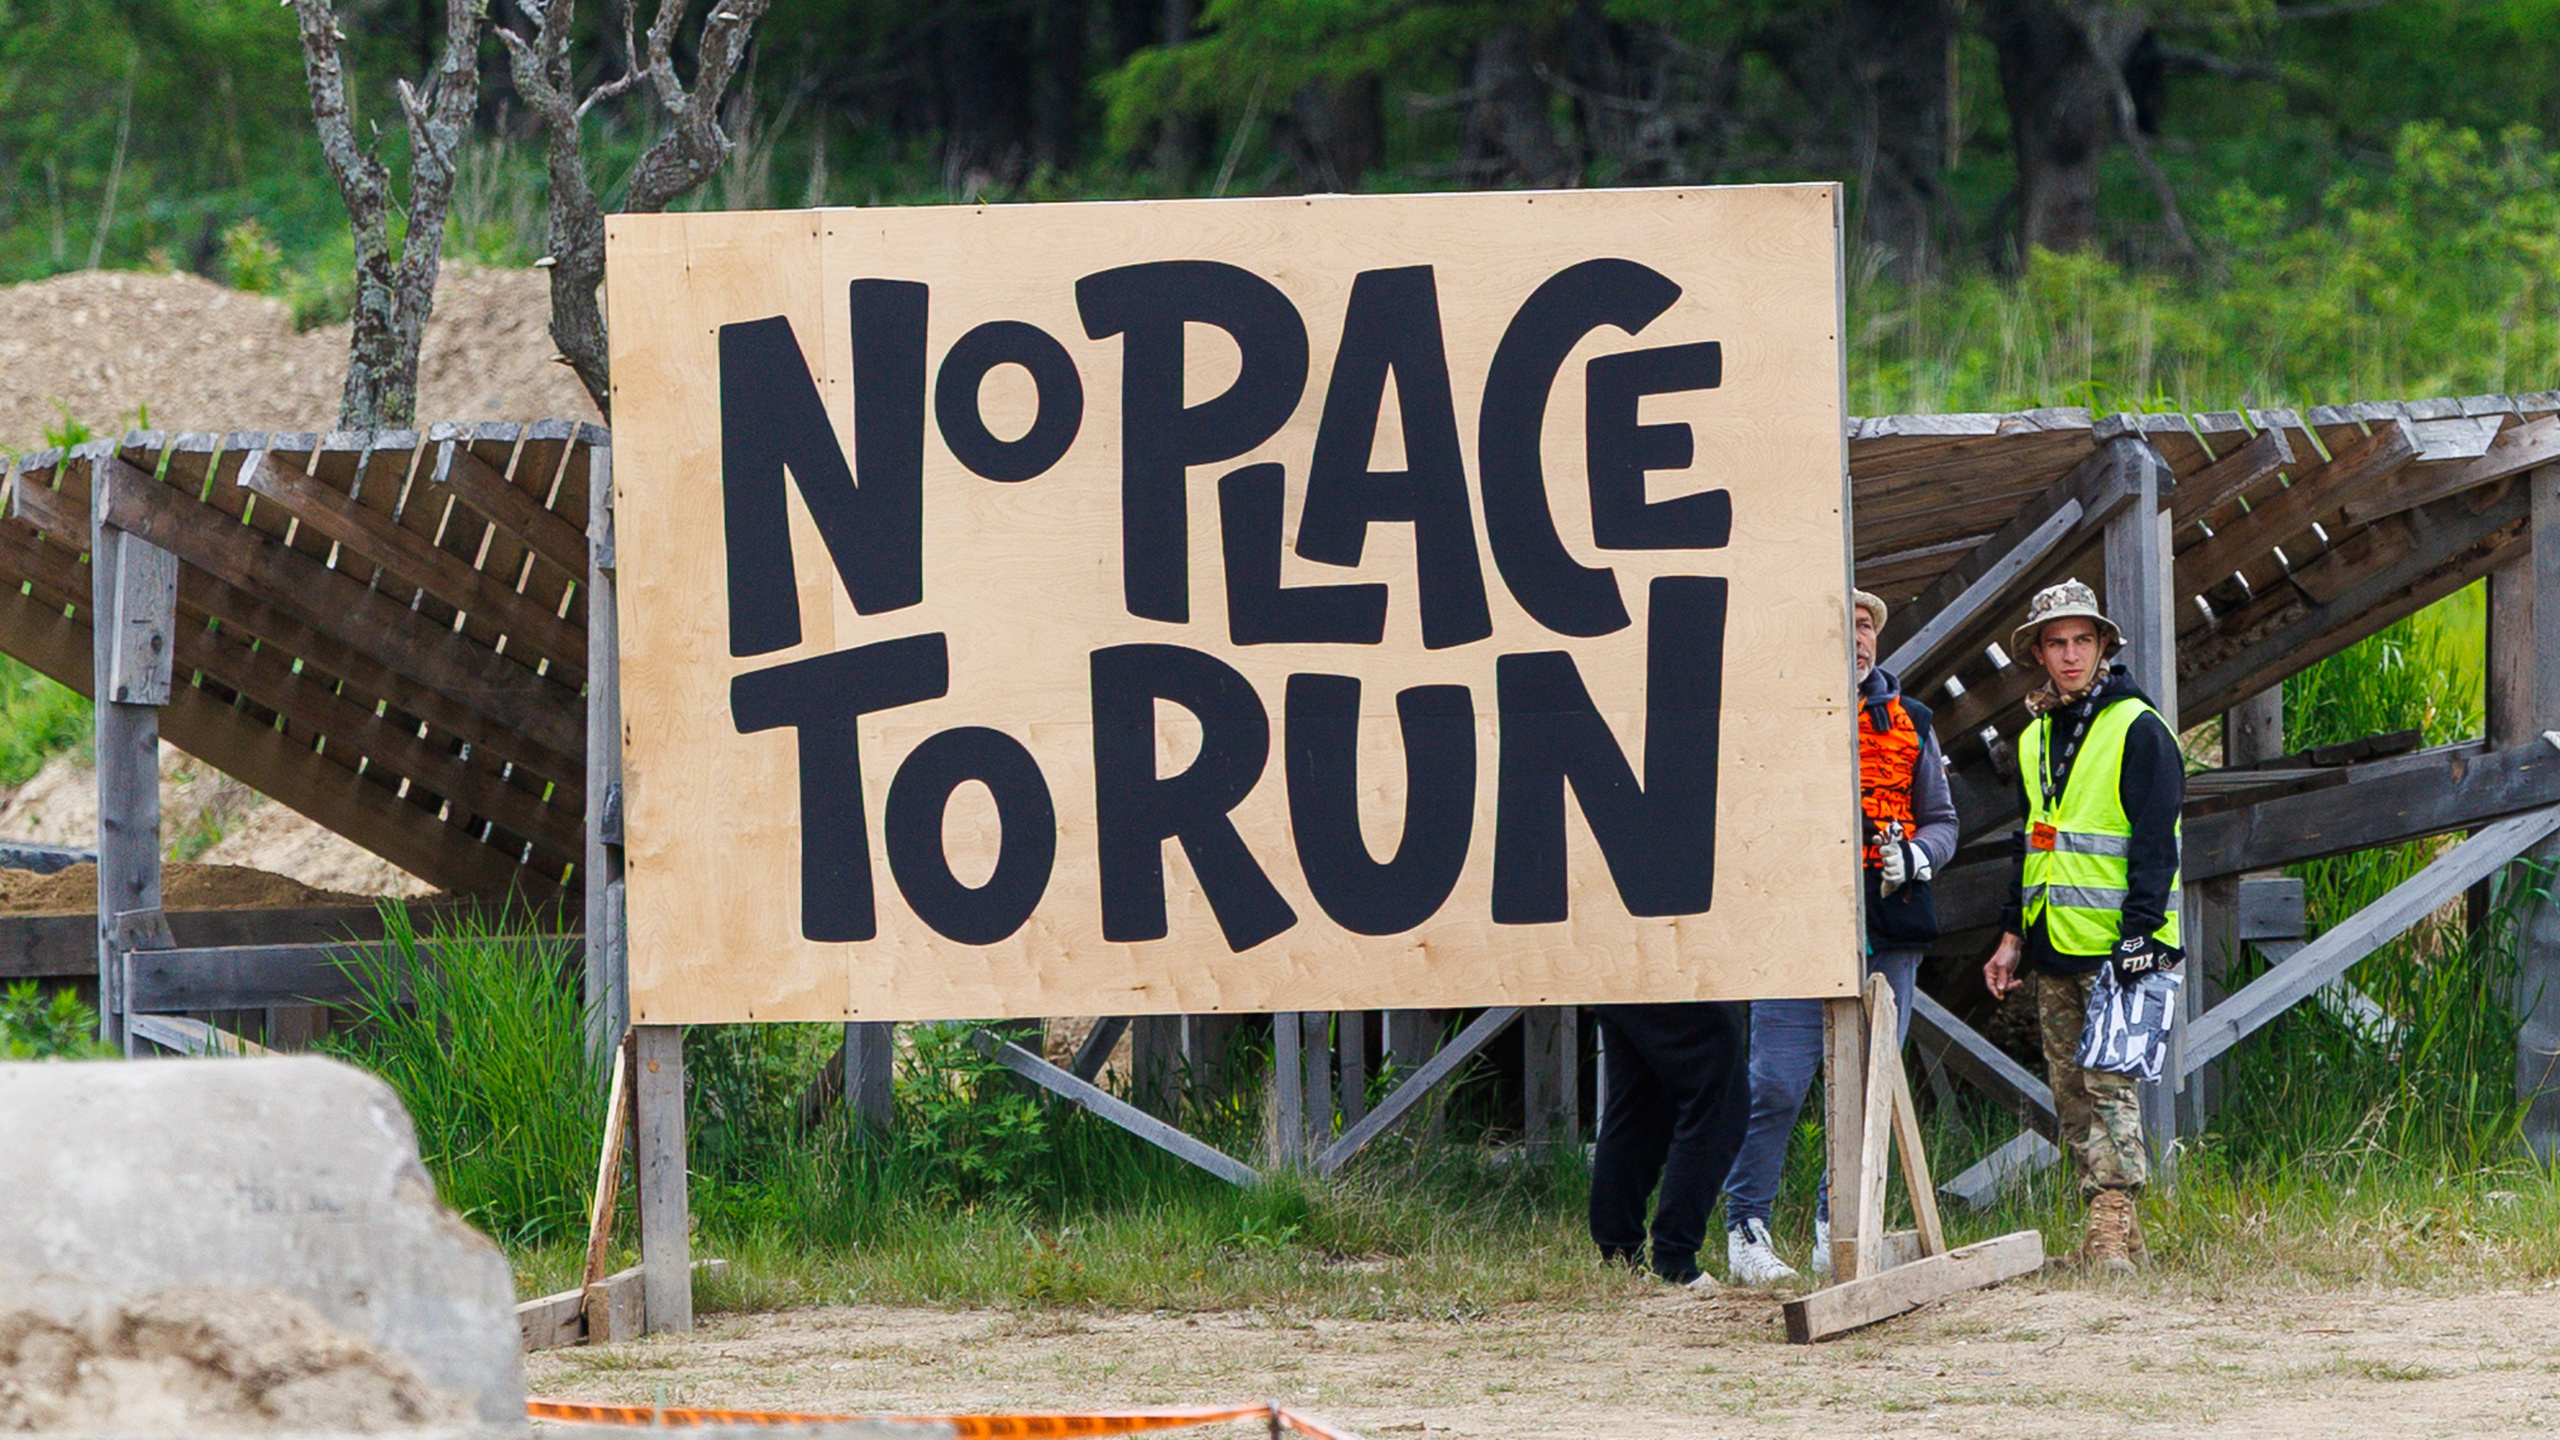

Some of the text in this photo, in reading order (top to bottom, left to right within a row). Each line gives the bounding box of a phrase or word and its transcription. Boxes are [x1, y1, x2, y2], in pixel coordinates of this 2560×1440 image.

[1076, 259, 1732, 649] PLACE
[1090, 576, 1727, 953] RUN
[2122, 952, 2154, 973] FOX
